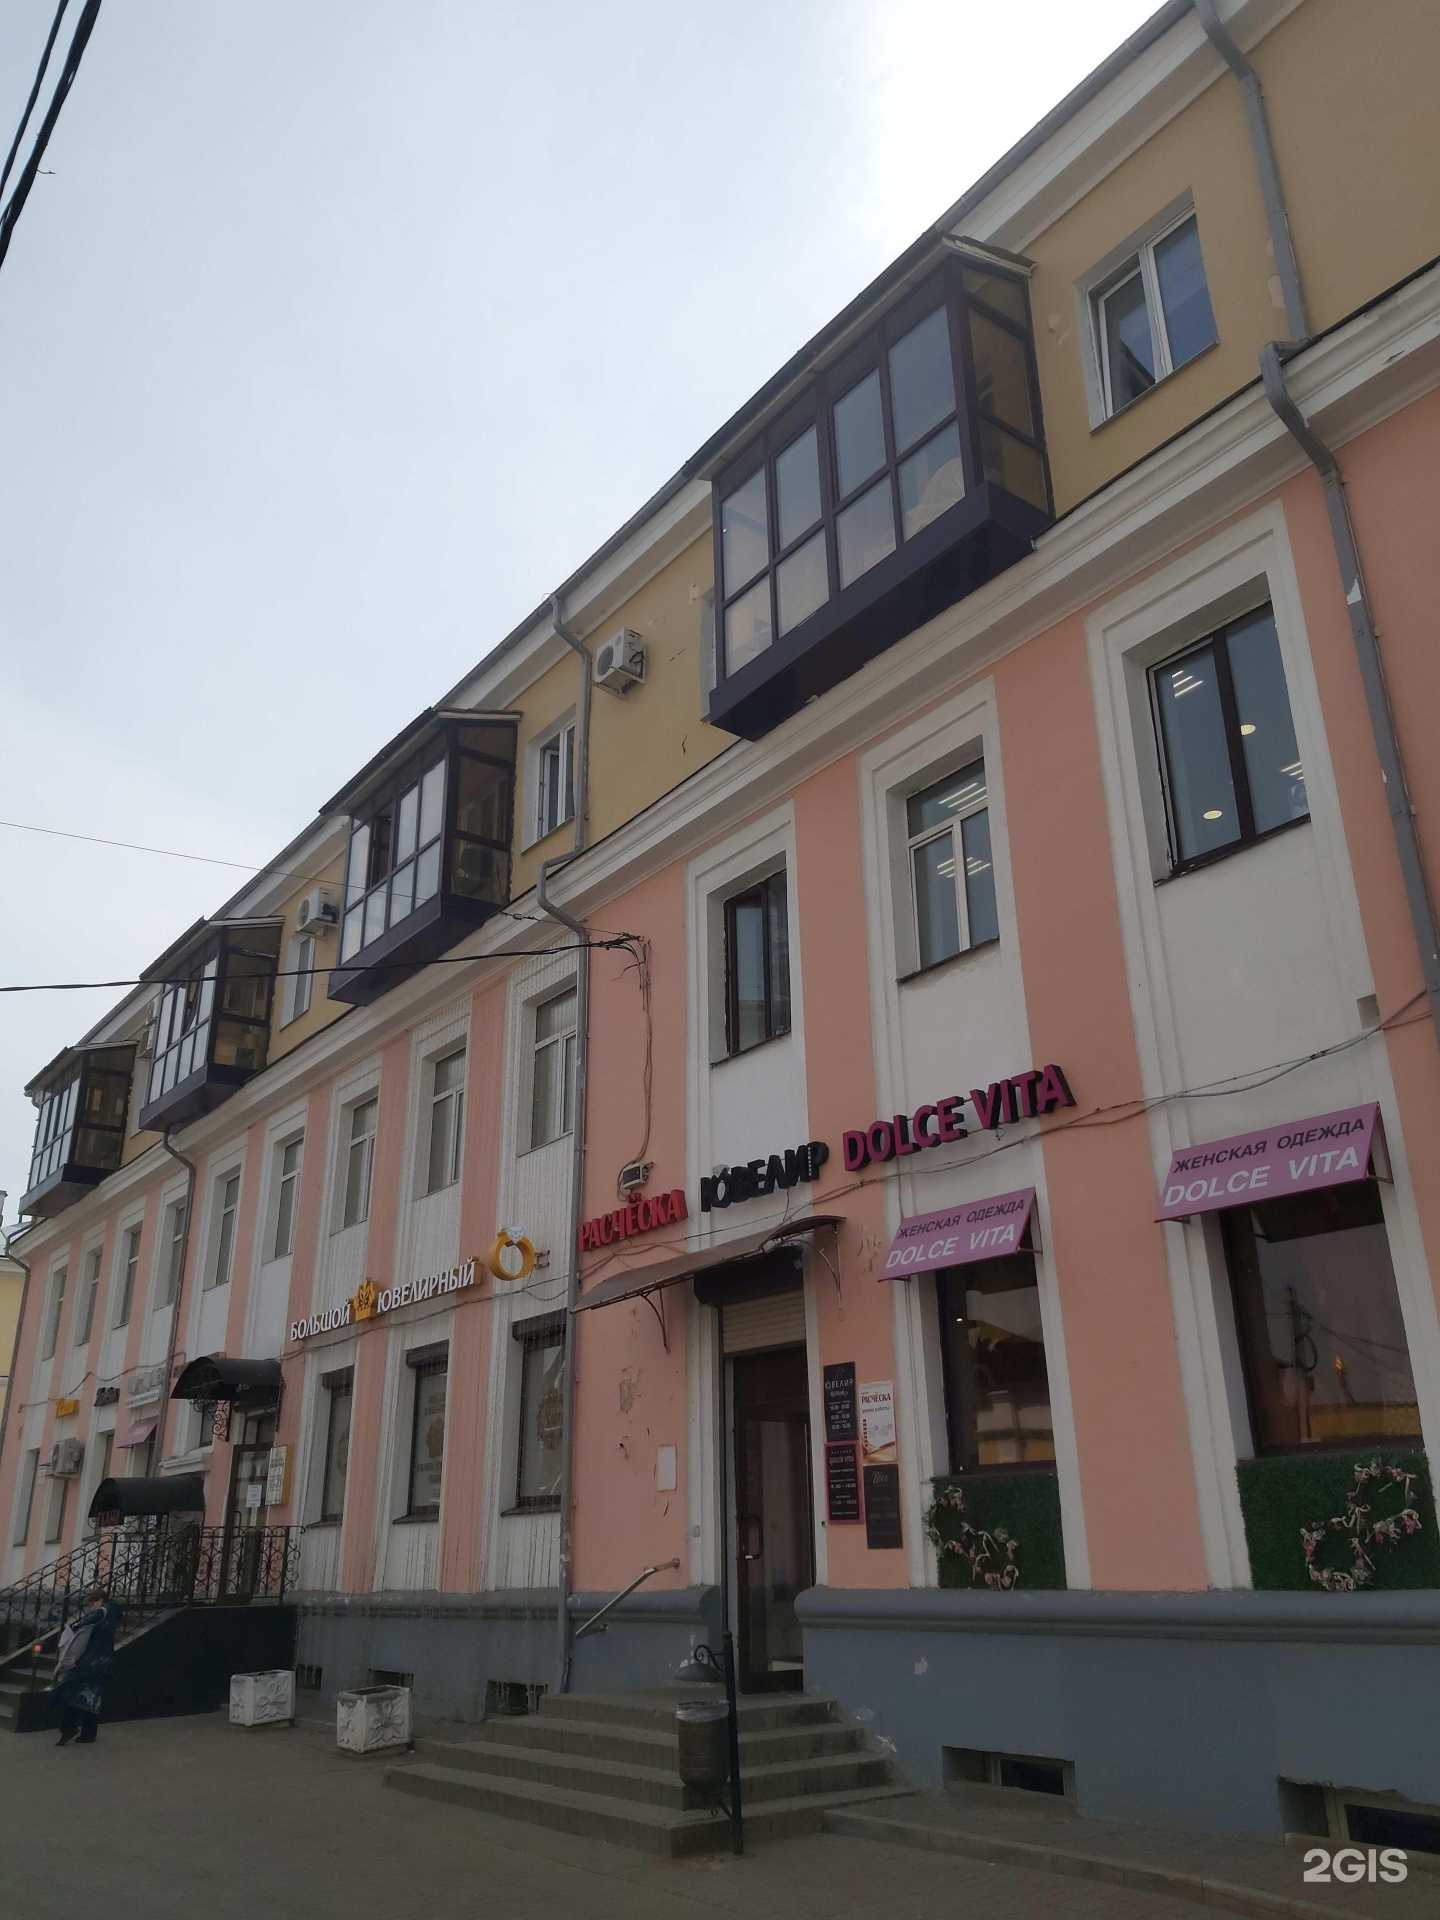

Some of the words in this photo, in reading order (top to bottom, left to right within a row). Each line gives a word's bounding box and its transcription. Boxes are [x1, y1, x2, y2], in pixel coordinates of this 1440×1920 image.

[842, 1096, 967, 1172] DOLCE
[970, 1064, 1077, 1129] VITA
[1174, 1142, 1267, 1174] ЖЕНСКАЯ
[1276, 1119, 1366, 1150] ОДЕЖДА
[700, 1141, 830, 1213] ЮВЕЛИР
[1163, 1166, 1271, 1209] DOLCE
[1288, 1146, 1361, 1181] VITA
[577, 1189, 688, 1253] РАСЧЁСКА
[886, 1237, 957, 1270] DOLCE
[970, 1224, 1017, 1249] VITA
[896, 1215, 960, 1241] ЖЕНСКАЯ
[965, 1200, 1026, 1224] ОДЕЖДА
[290, 1299, 352, 1342] БОЛЬШОЙ
[376, 1256, 477, 1313] ЮВЕЛИРНЫЙ
